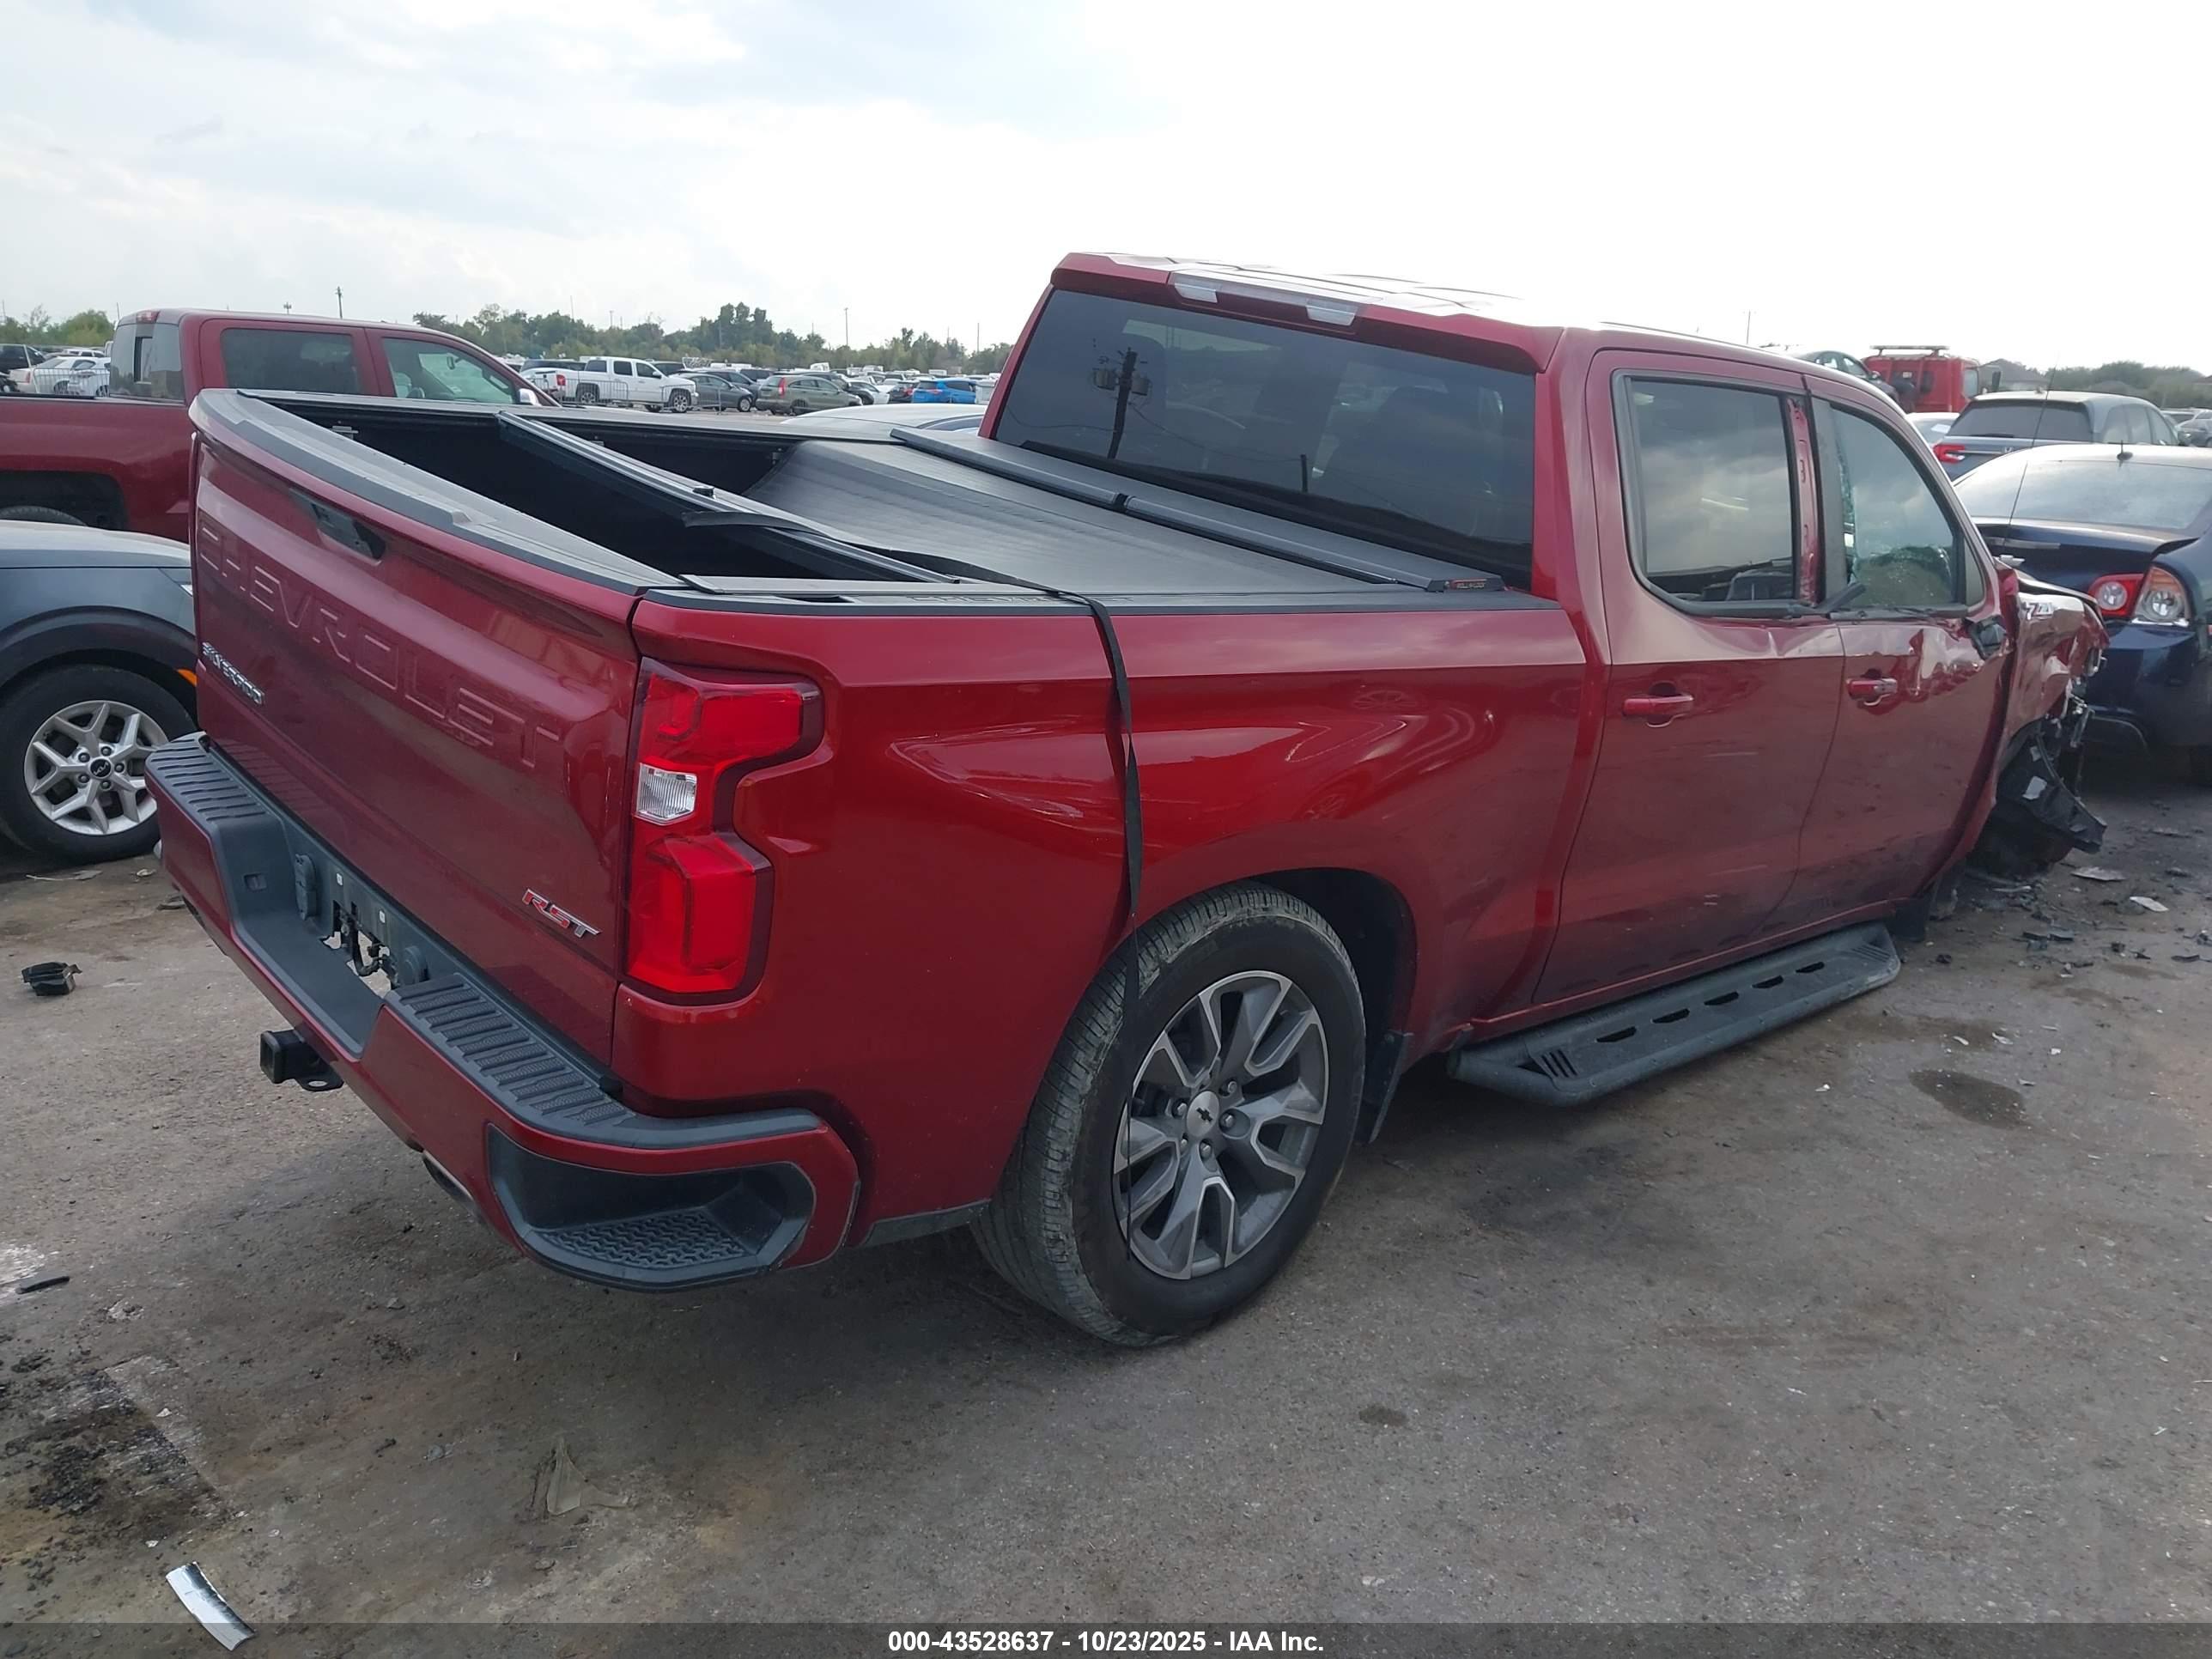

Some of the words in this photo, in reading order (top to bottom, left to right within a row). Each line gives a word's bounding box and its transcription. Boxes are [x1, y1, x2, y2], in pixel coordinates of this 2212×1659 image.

[197, 520, 560, 769] CHEVROLET
[203, 641, 264, 705] SILVERADO
[521, 888, 601, 939] RST
